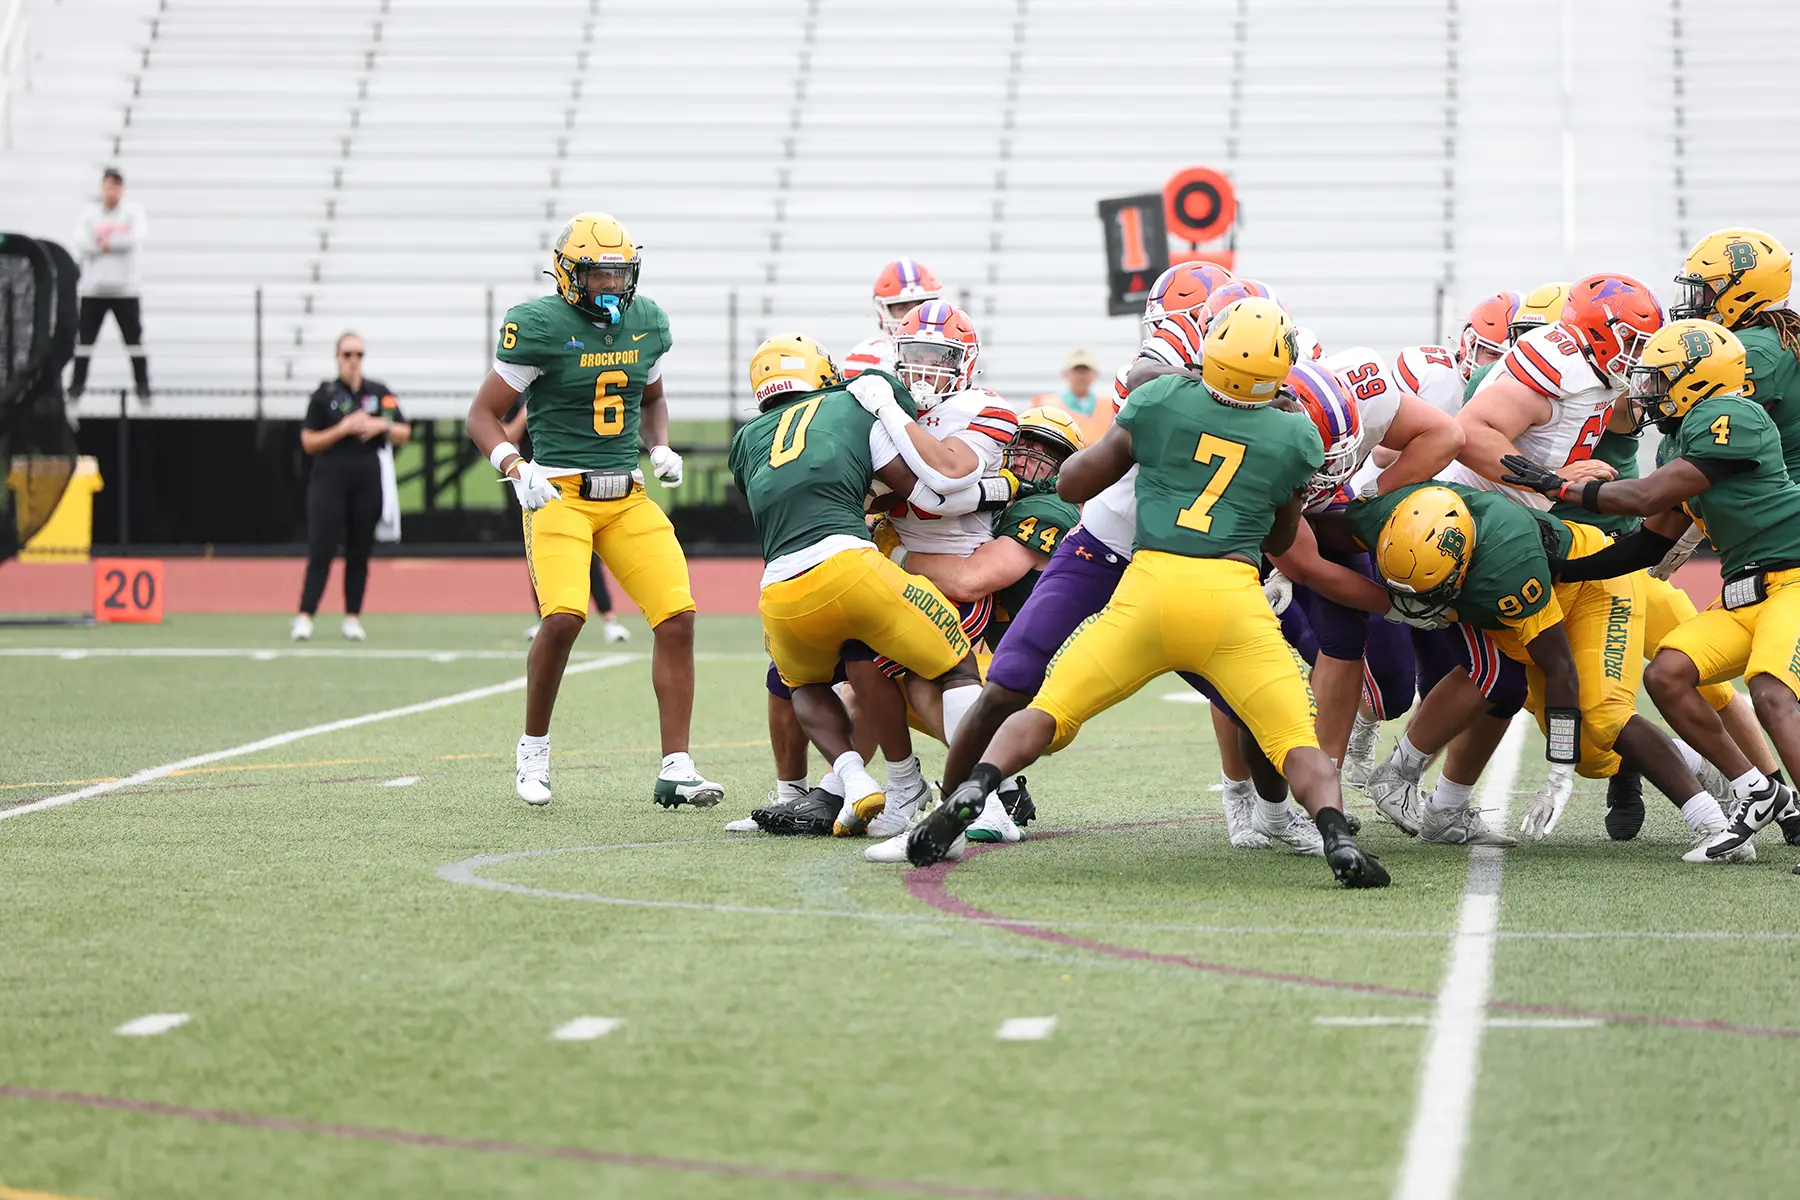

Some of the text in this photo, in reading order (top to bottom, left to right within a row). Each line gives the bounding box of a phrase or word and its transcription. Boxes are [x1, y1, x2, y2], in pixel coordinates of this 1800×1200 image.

[1116, 206, 1150, 273] 1
[501, 321, 519, 350] 6
[1544, 330, 1578, 356] 60
[579, 349, 640, 368] BROCKPORT
[1420, 346, 1453, 369] 67
[756, 380, 793, 402] Riddell
[1346, 362, 1387, 400] 59
[593, 369, 629, 436] 6
[768, 394, 828, 471] 0
[1709, 414, 1731, 446] 4
[1174, 431, 1248, 535] 7
[1016, 515, 1060, 555] 44
[104, 569, 155, 609] 20
[1497, 577, 1543, 618] 90
[902, 583, 968, 656] BROCKPORT
[1604, 596, 1631, 681] BROCKPORT
